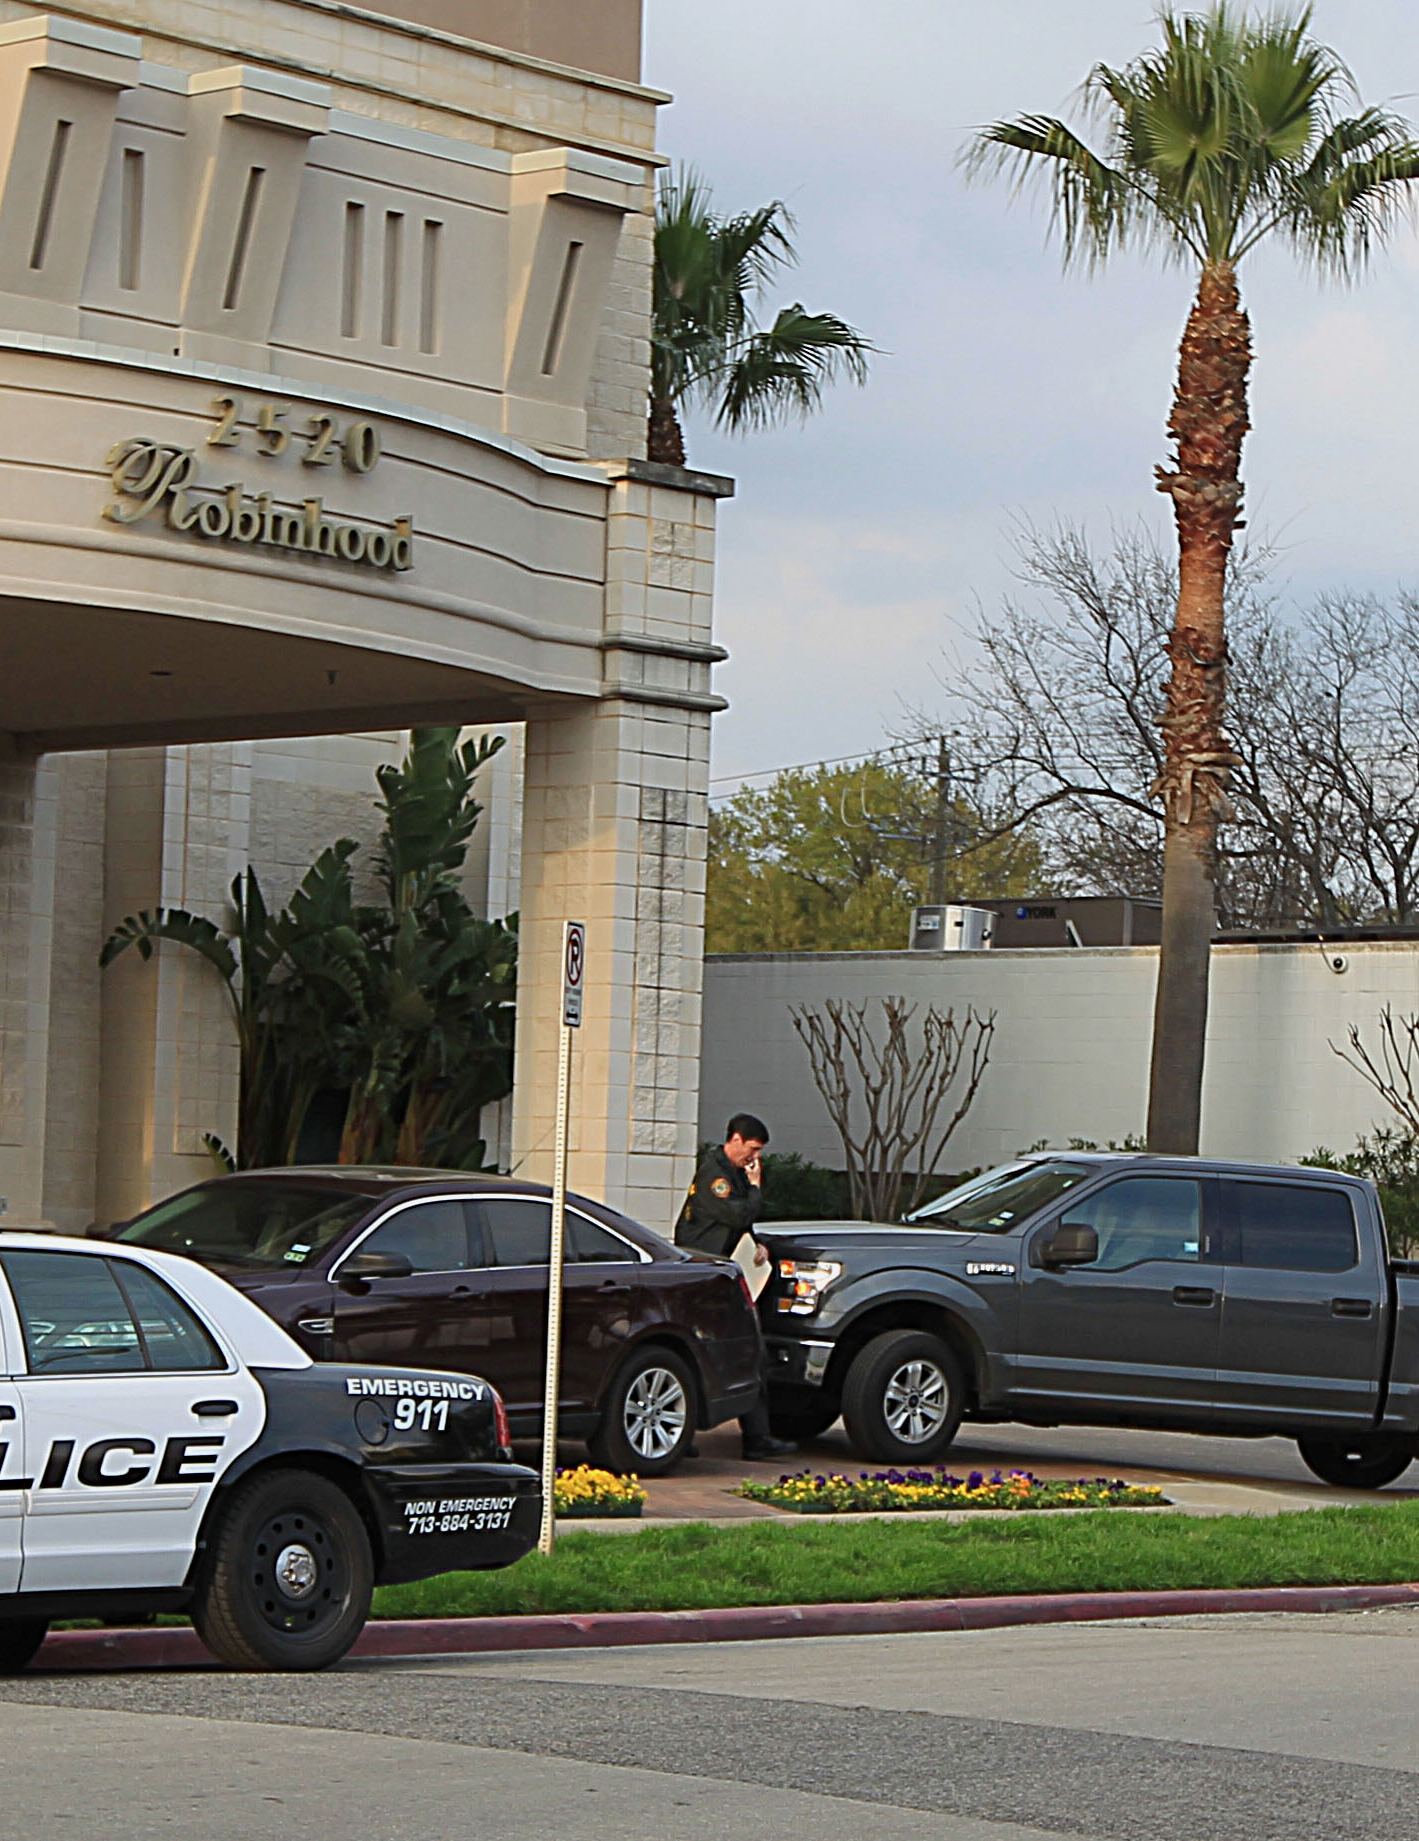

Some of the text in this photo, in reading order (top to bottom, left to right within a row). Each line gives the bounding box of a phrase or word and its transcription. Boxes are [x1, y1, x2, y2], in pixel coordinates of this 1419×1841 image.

[207, 396, 382, 474] 2520
[101, 436, 414, 571] Robinhood
[346, 1378, 484, 1401] EMERGENCY
[393, 1398, 449, 1431] 911
[404, 1497, 517, 1516] NON EMERGENCY
[408, 1511, 511, 1535] 713-884-3131
